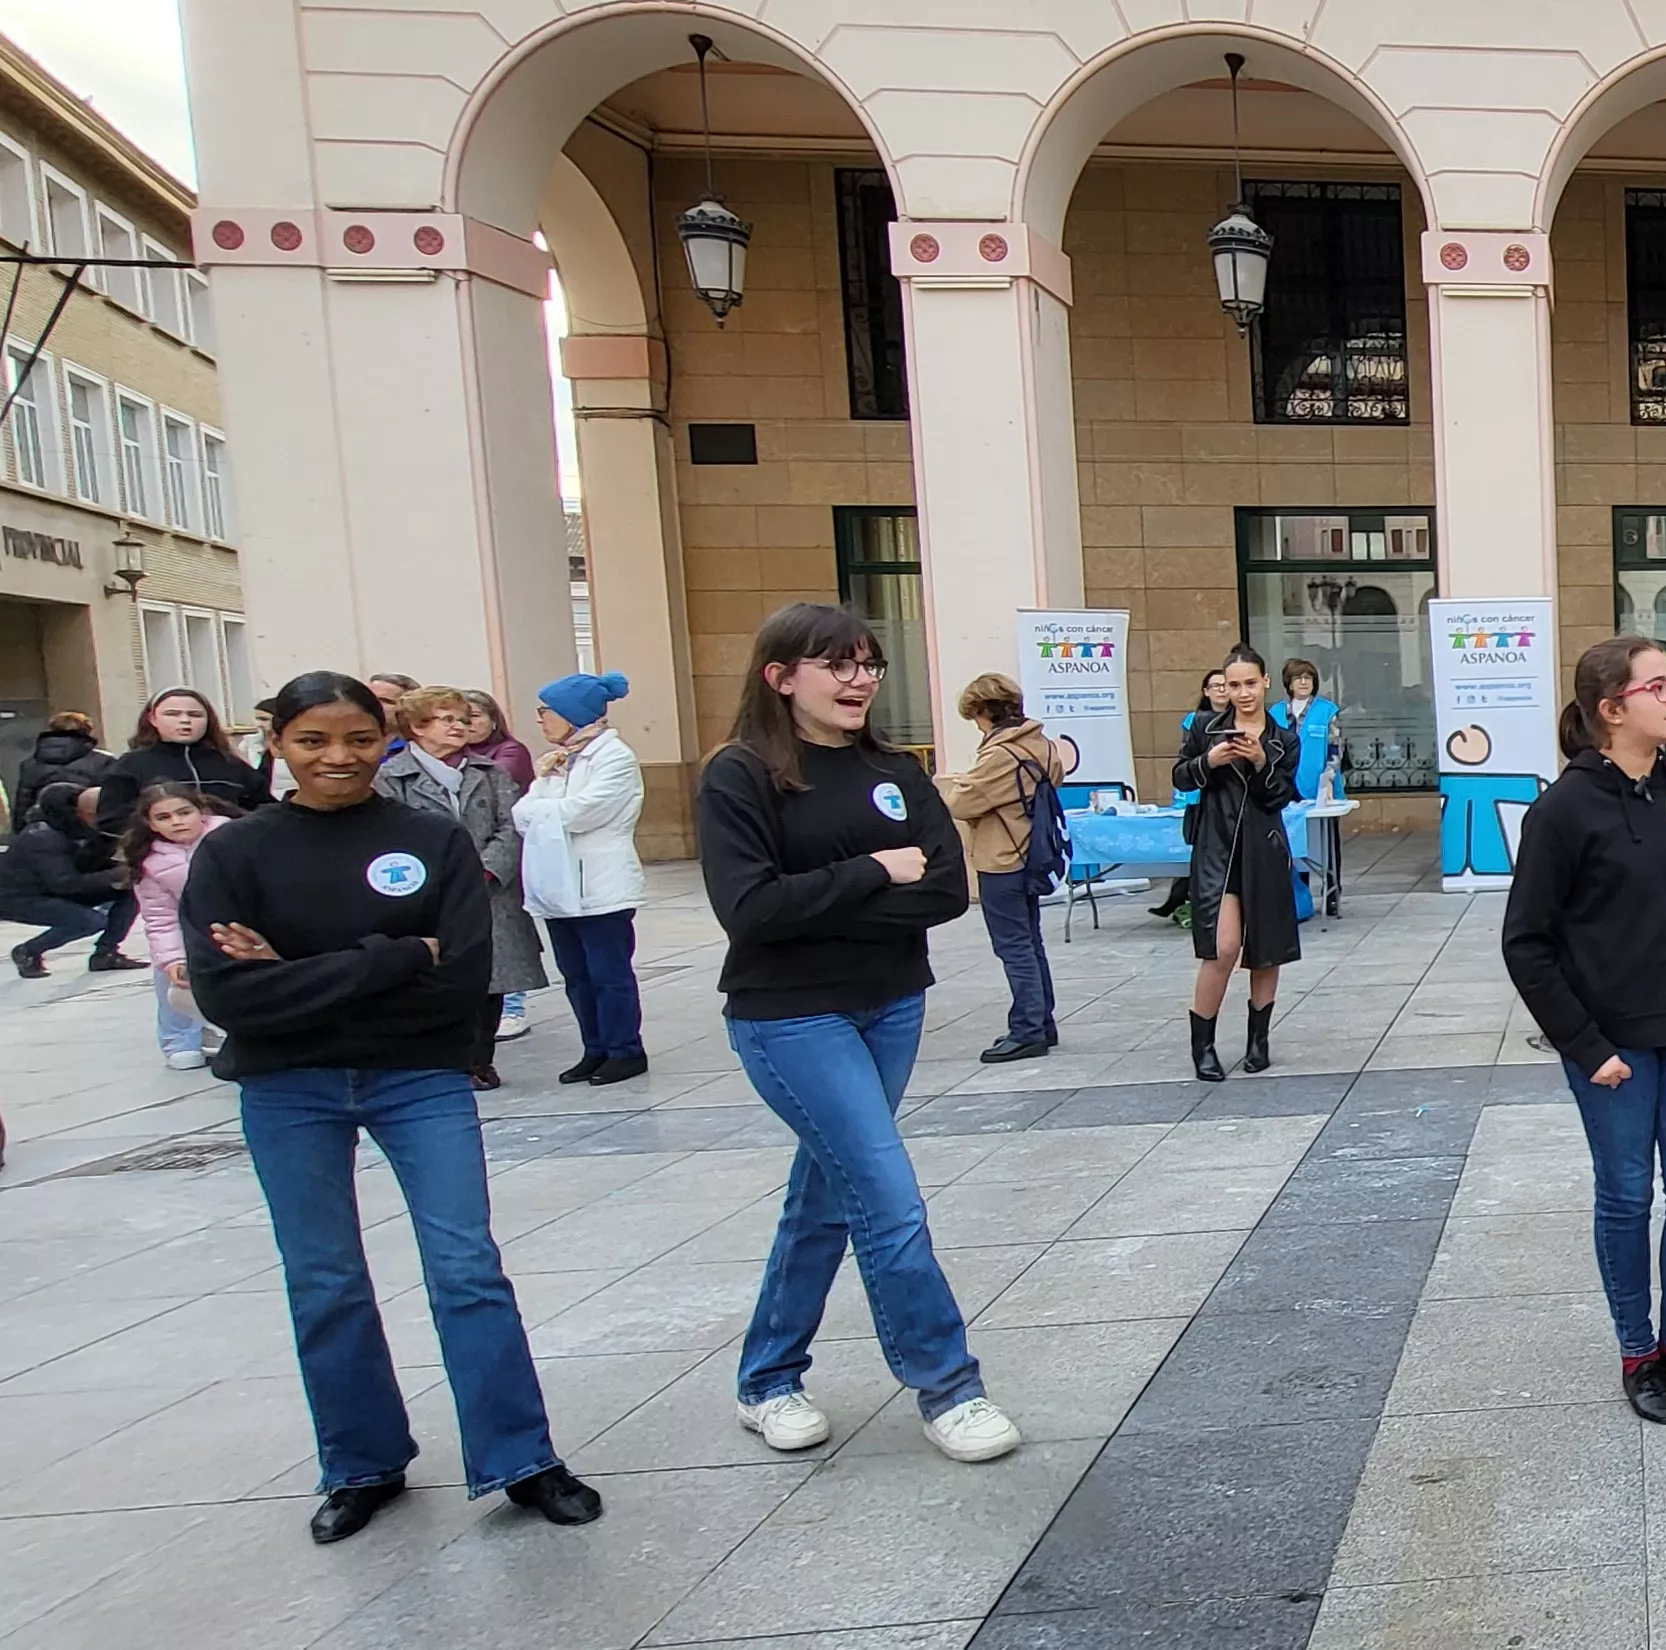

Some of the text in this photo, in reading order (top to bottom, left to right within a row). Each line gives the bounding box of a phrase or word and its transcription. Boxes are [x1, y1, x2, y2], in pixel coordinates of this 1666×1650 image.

[2, 525, 84, 570] PROVINCIAL
[1502, 614, 1536, 622] cáncer
[1085, 624, 1114, 633] cáncer
[1460, 652, 1527, 664] ASPANOA
[1048, 662, 1110, 673] ASPANOA
